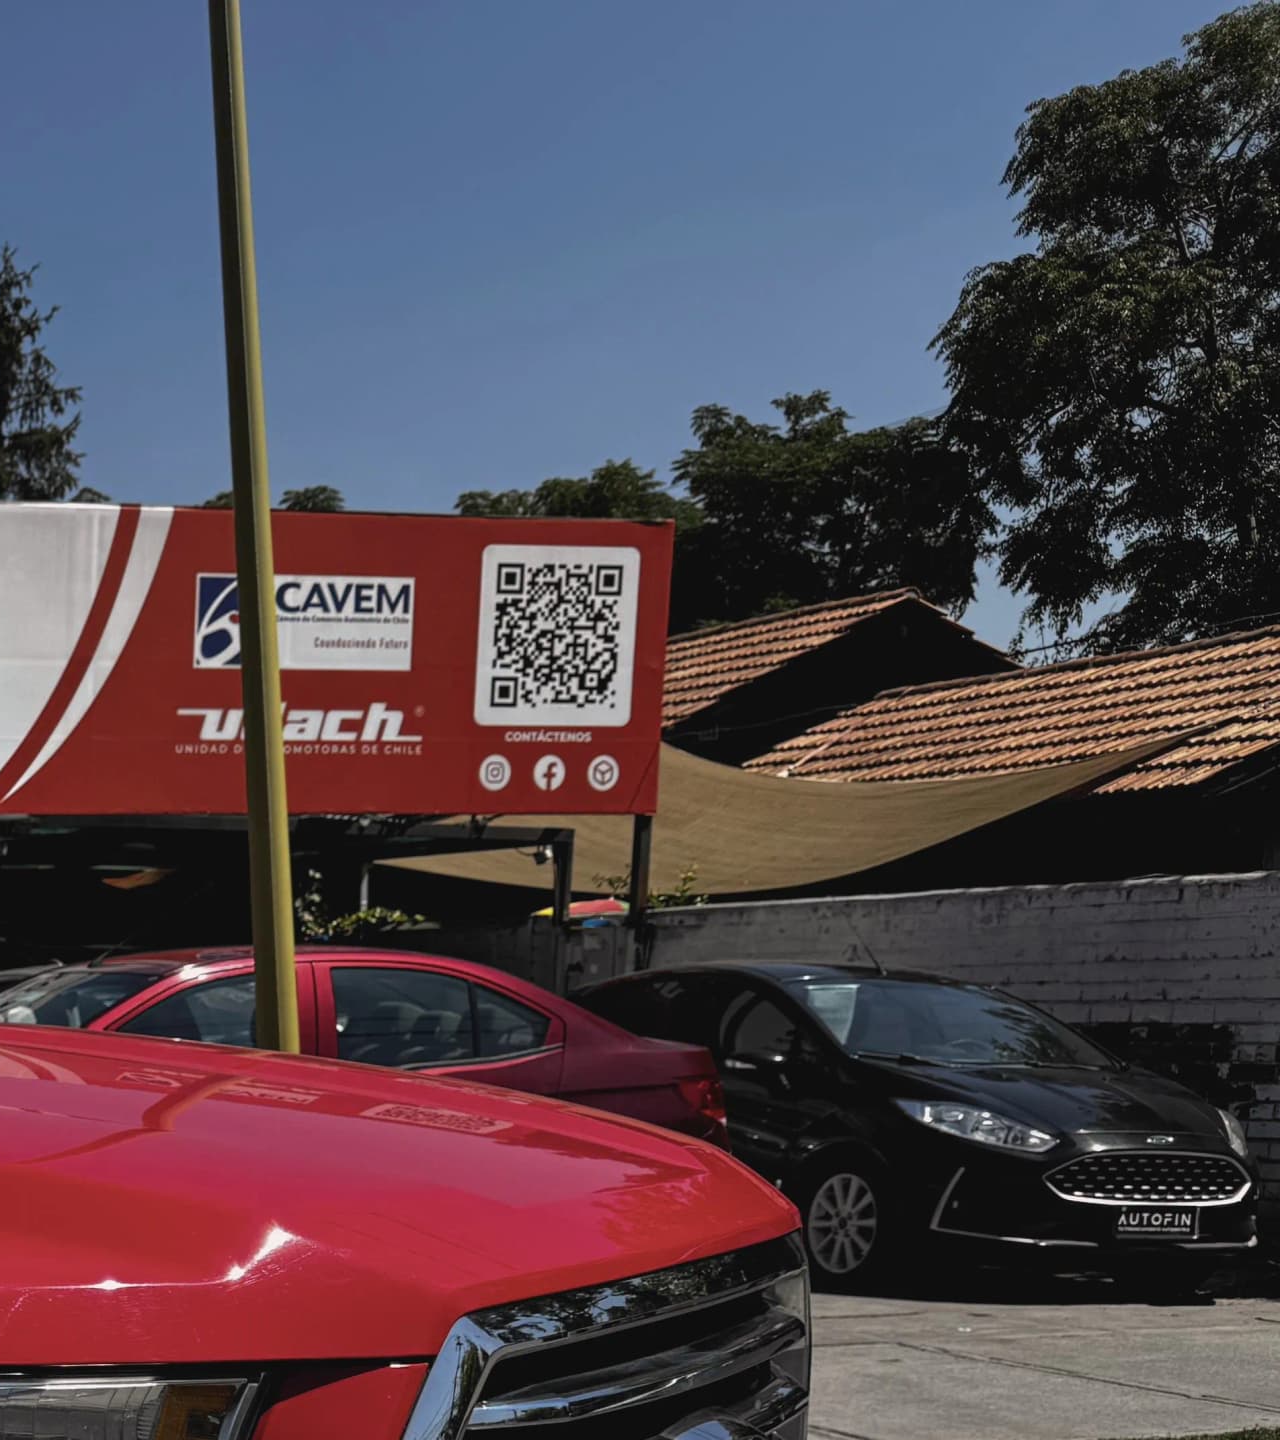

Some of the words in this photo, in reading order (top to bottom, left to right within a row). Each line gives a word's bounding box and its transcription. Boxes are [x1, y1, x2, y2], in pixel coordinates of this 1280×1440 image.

[275, 582, 411, 614] CAVEM
[175, 744, 228, 754] UNIDAD
[384, 745, 424, 755] CHILE
[1118, 1212, 1192, 1226] AUTOFIN
